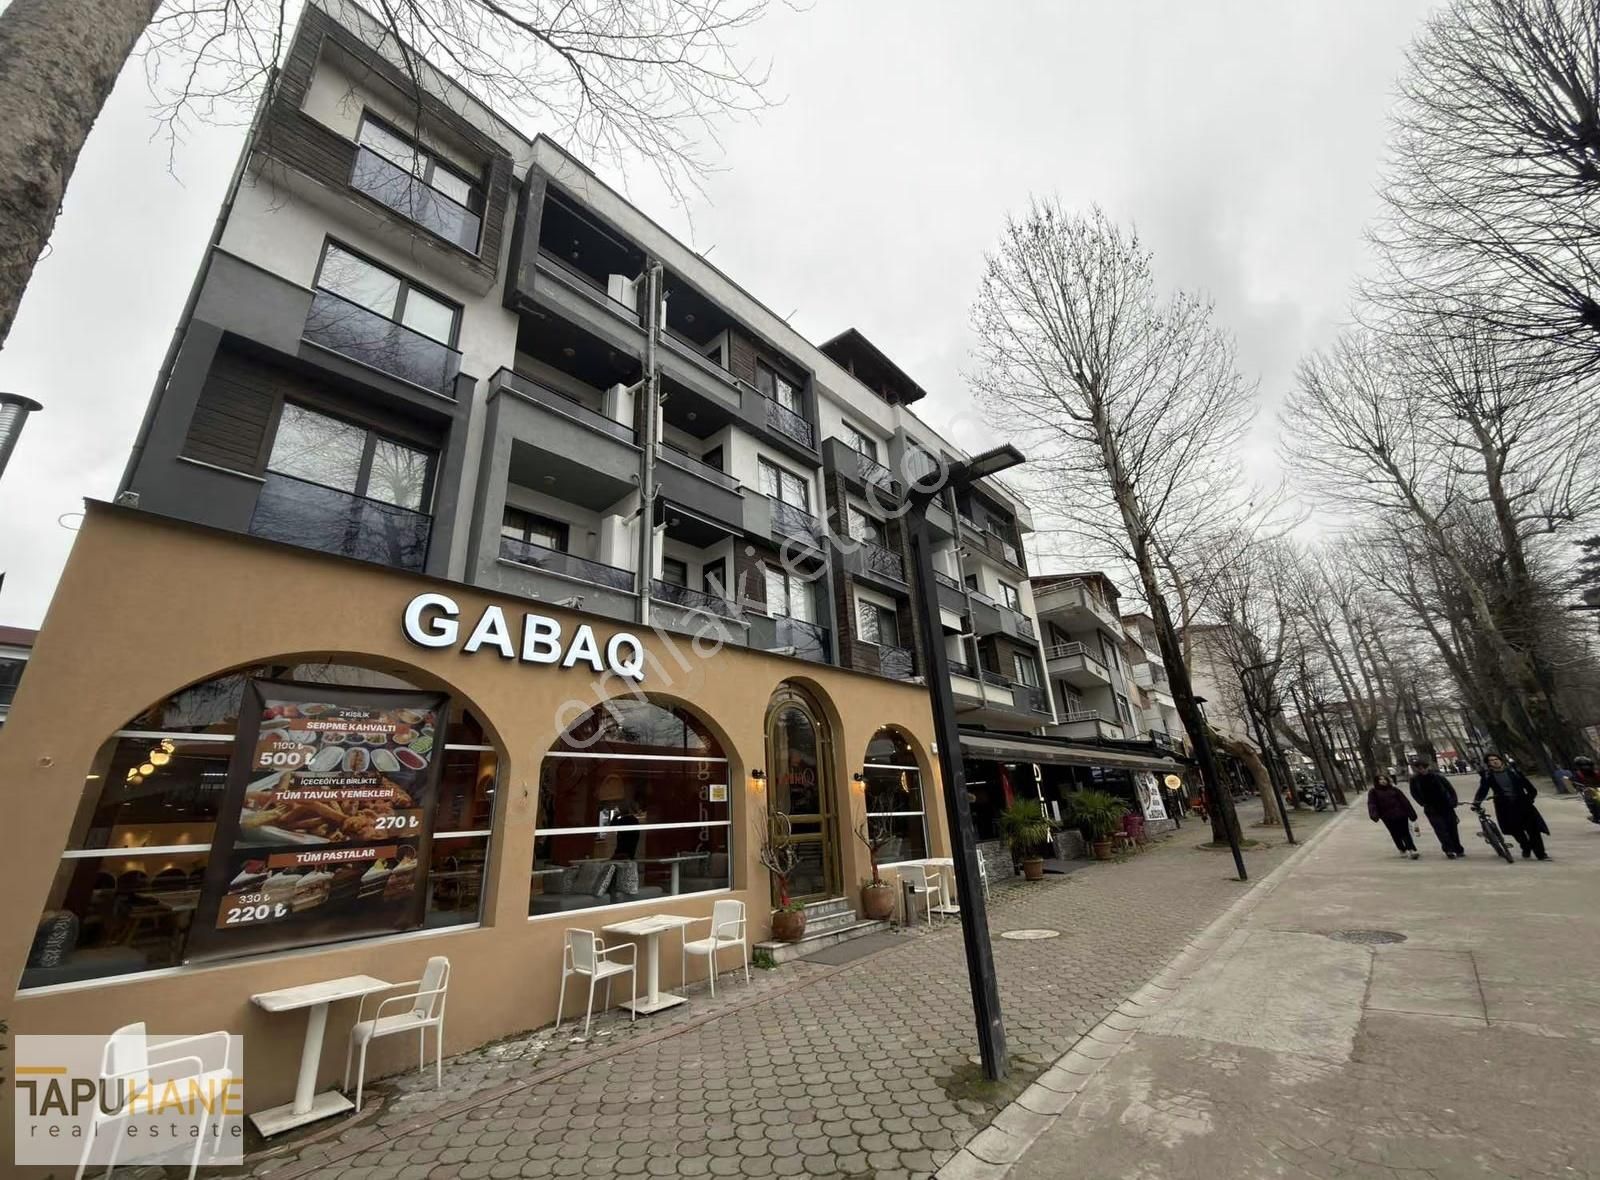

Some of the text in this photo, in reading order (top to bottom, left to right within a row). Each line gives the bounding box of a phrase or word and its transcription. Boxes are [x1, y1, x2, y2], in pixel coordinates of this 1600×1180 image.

[402, 592, 645, 682] GABAQ
[307, 721, 396, 732] SERPME KAHVALTI
[273, 741, 296, 750] 1100
[260, 752, 301, 765] 500
[276, 788, 394, 800] TÜM TAVUK YEMEKLERİ
[375, 816, 406, 830] 270
[296, 849, 376, 863] TÜM PASTALAR
[239, 893, 261, 904] 330
[226, 905, 270, 924] 220
